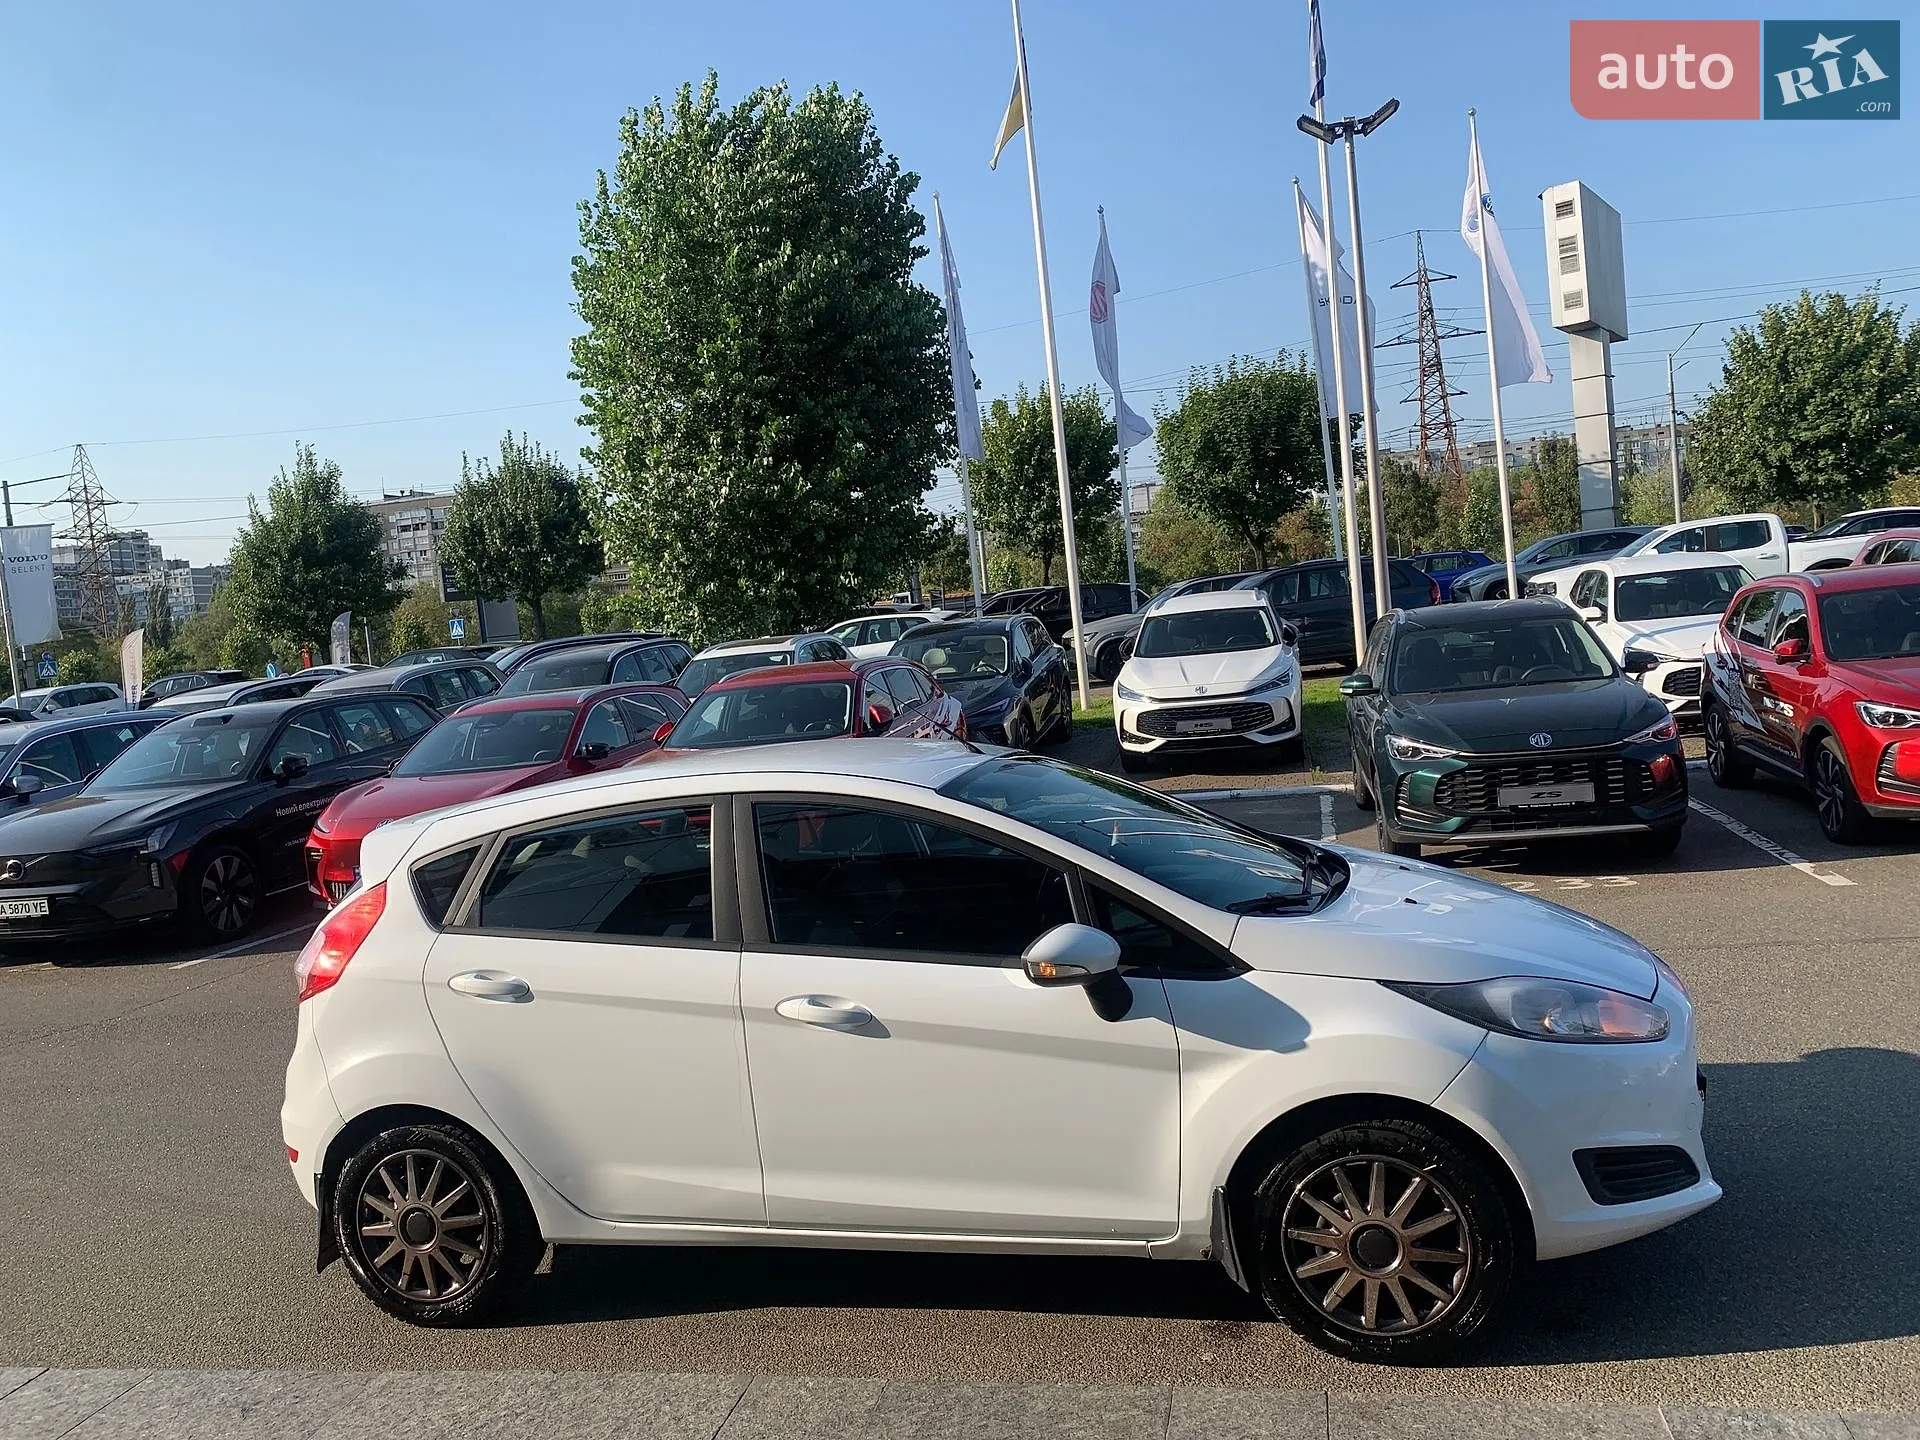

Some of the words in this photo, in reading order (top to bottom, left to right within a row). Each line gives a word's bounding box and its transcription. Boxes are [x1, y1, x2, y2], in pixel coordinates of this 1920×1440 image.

[8, 554, 48, 563] VOLVO
[11, 564, 45, 573] SELEKT
[1529, 732, 1552, 748] MG
[1530, 791, 1563, 799] ZS
[275, 803, 298, 817] Новий
[9, 903, 30, 914] 5870
[32, 901, 47, 913] YE
